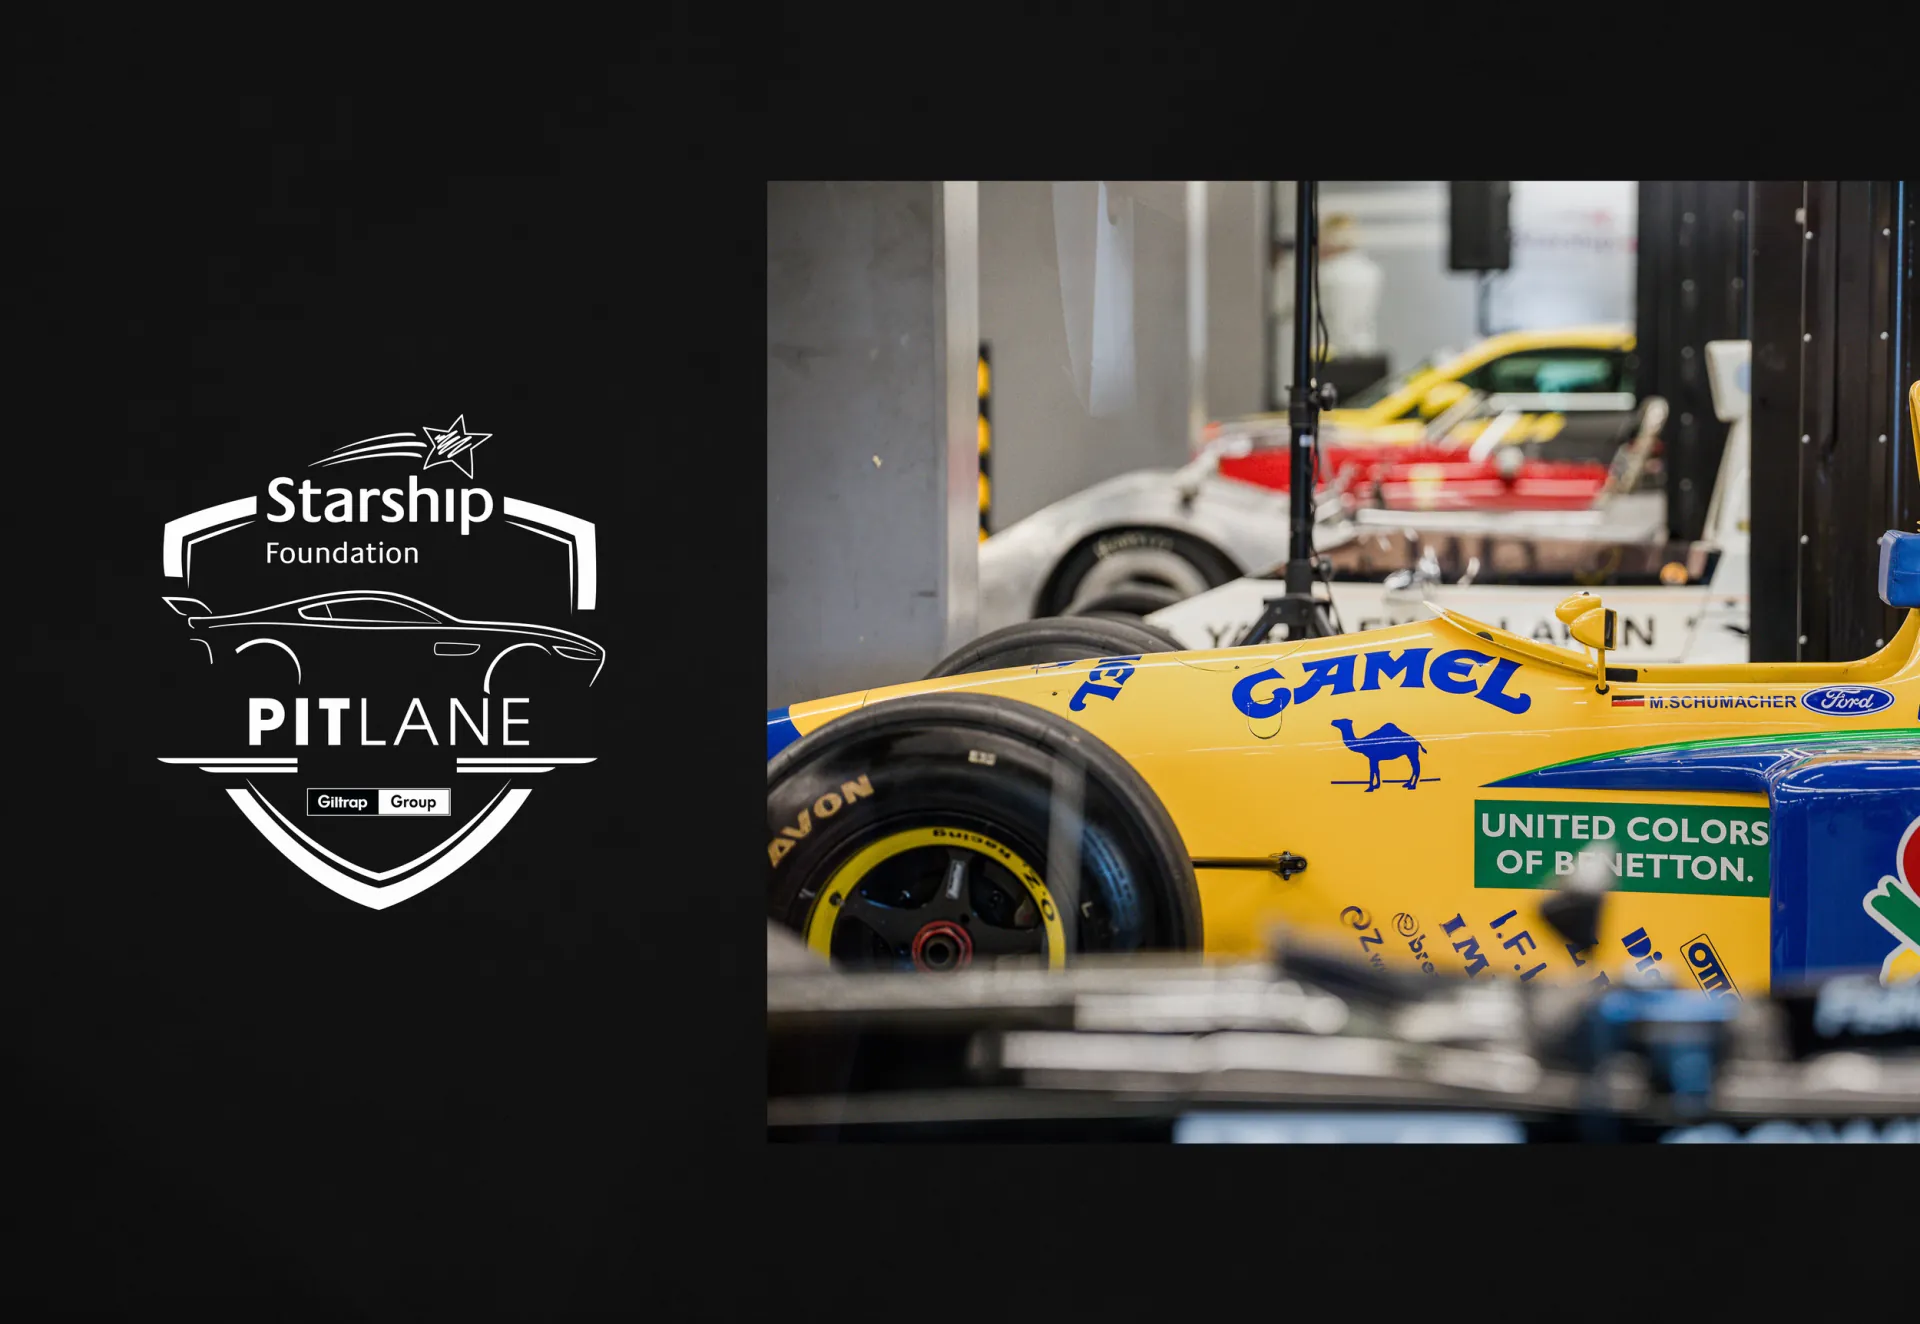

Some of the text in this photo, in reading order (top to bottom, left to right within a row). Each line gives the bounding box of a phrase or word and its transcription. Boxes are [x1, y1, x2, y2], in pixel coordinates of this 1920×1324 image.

[1231, 647, 1532, 715] CAMEL
[1649, 695, 1797, 709] M.SCHUMACHER
[766, 774, 875, 868] AVON
[1482, 813, 1769, 846] UNITED COLORS
[1496, 850, 1543, 875] OF
